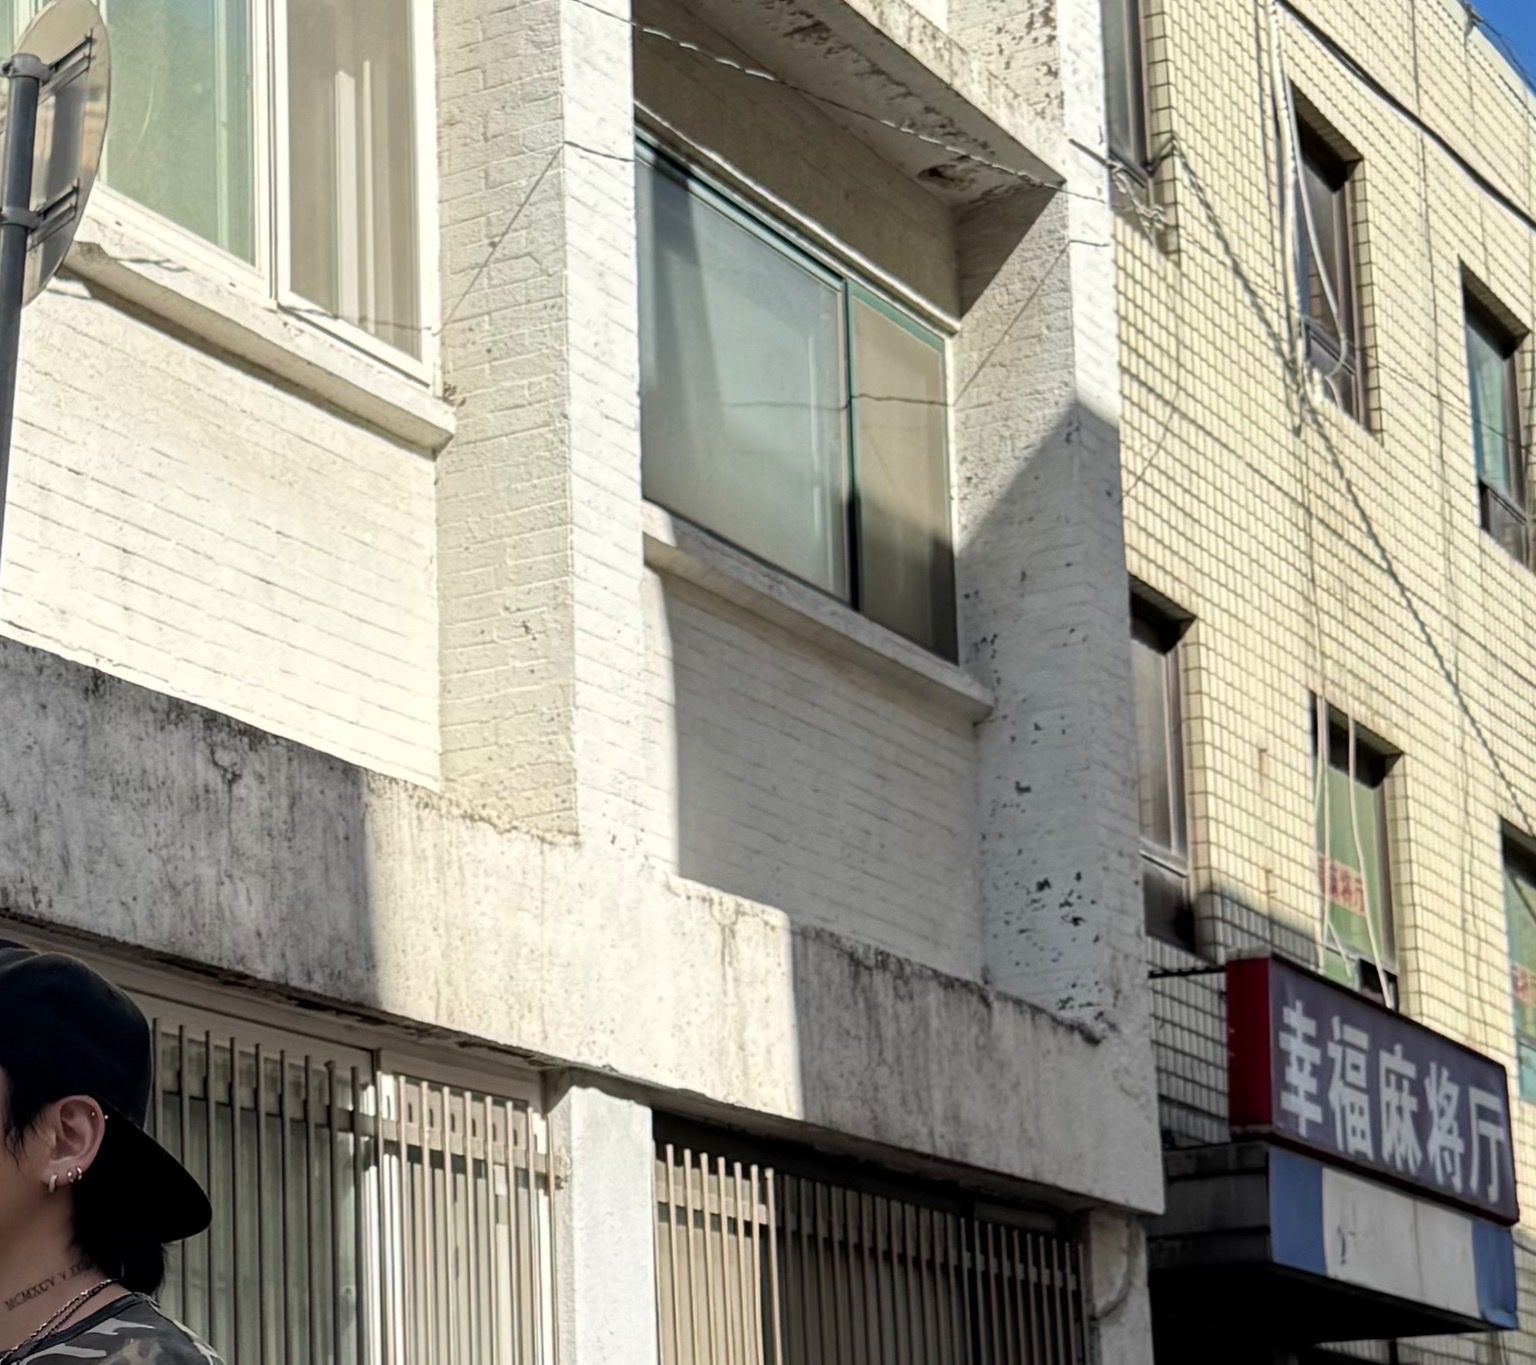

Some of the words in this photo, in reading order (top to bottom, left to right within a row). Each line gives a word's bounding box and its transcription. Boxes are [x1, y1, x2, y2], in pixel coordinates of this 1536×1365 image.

[1278, 999, 1506, 1204] 幸福麻将厅
